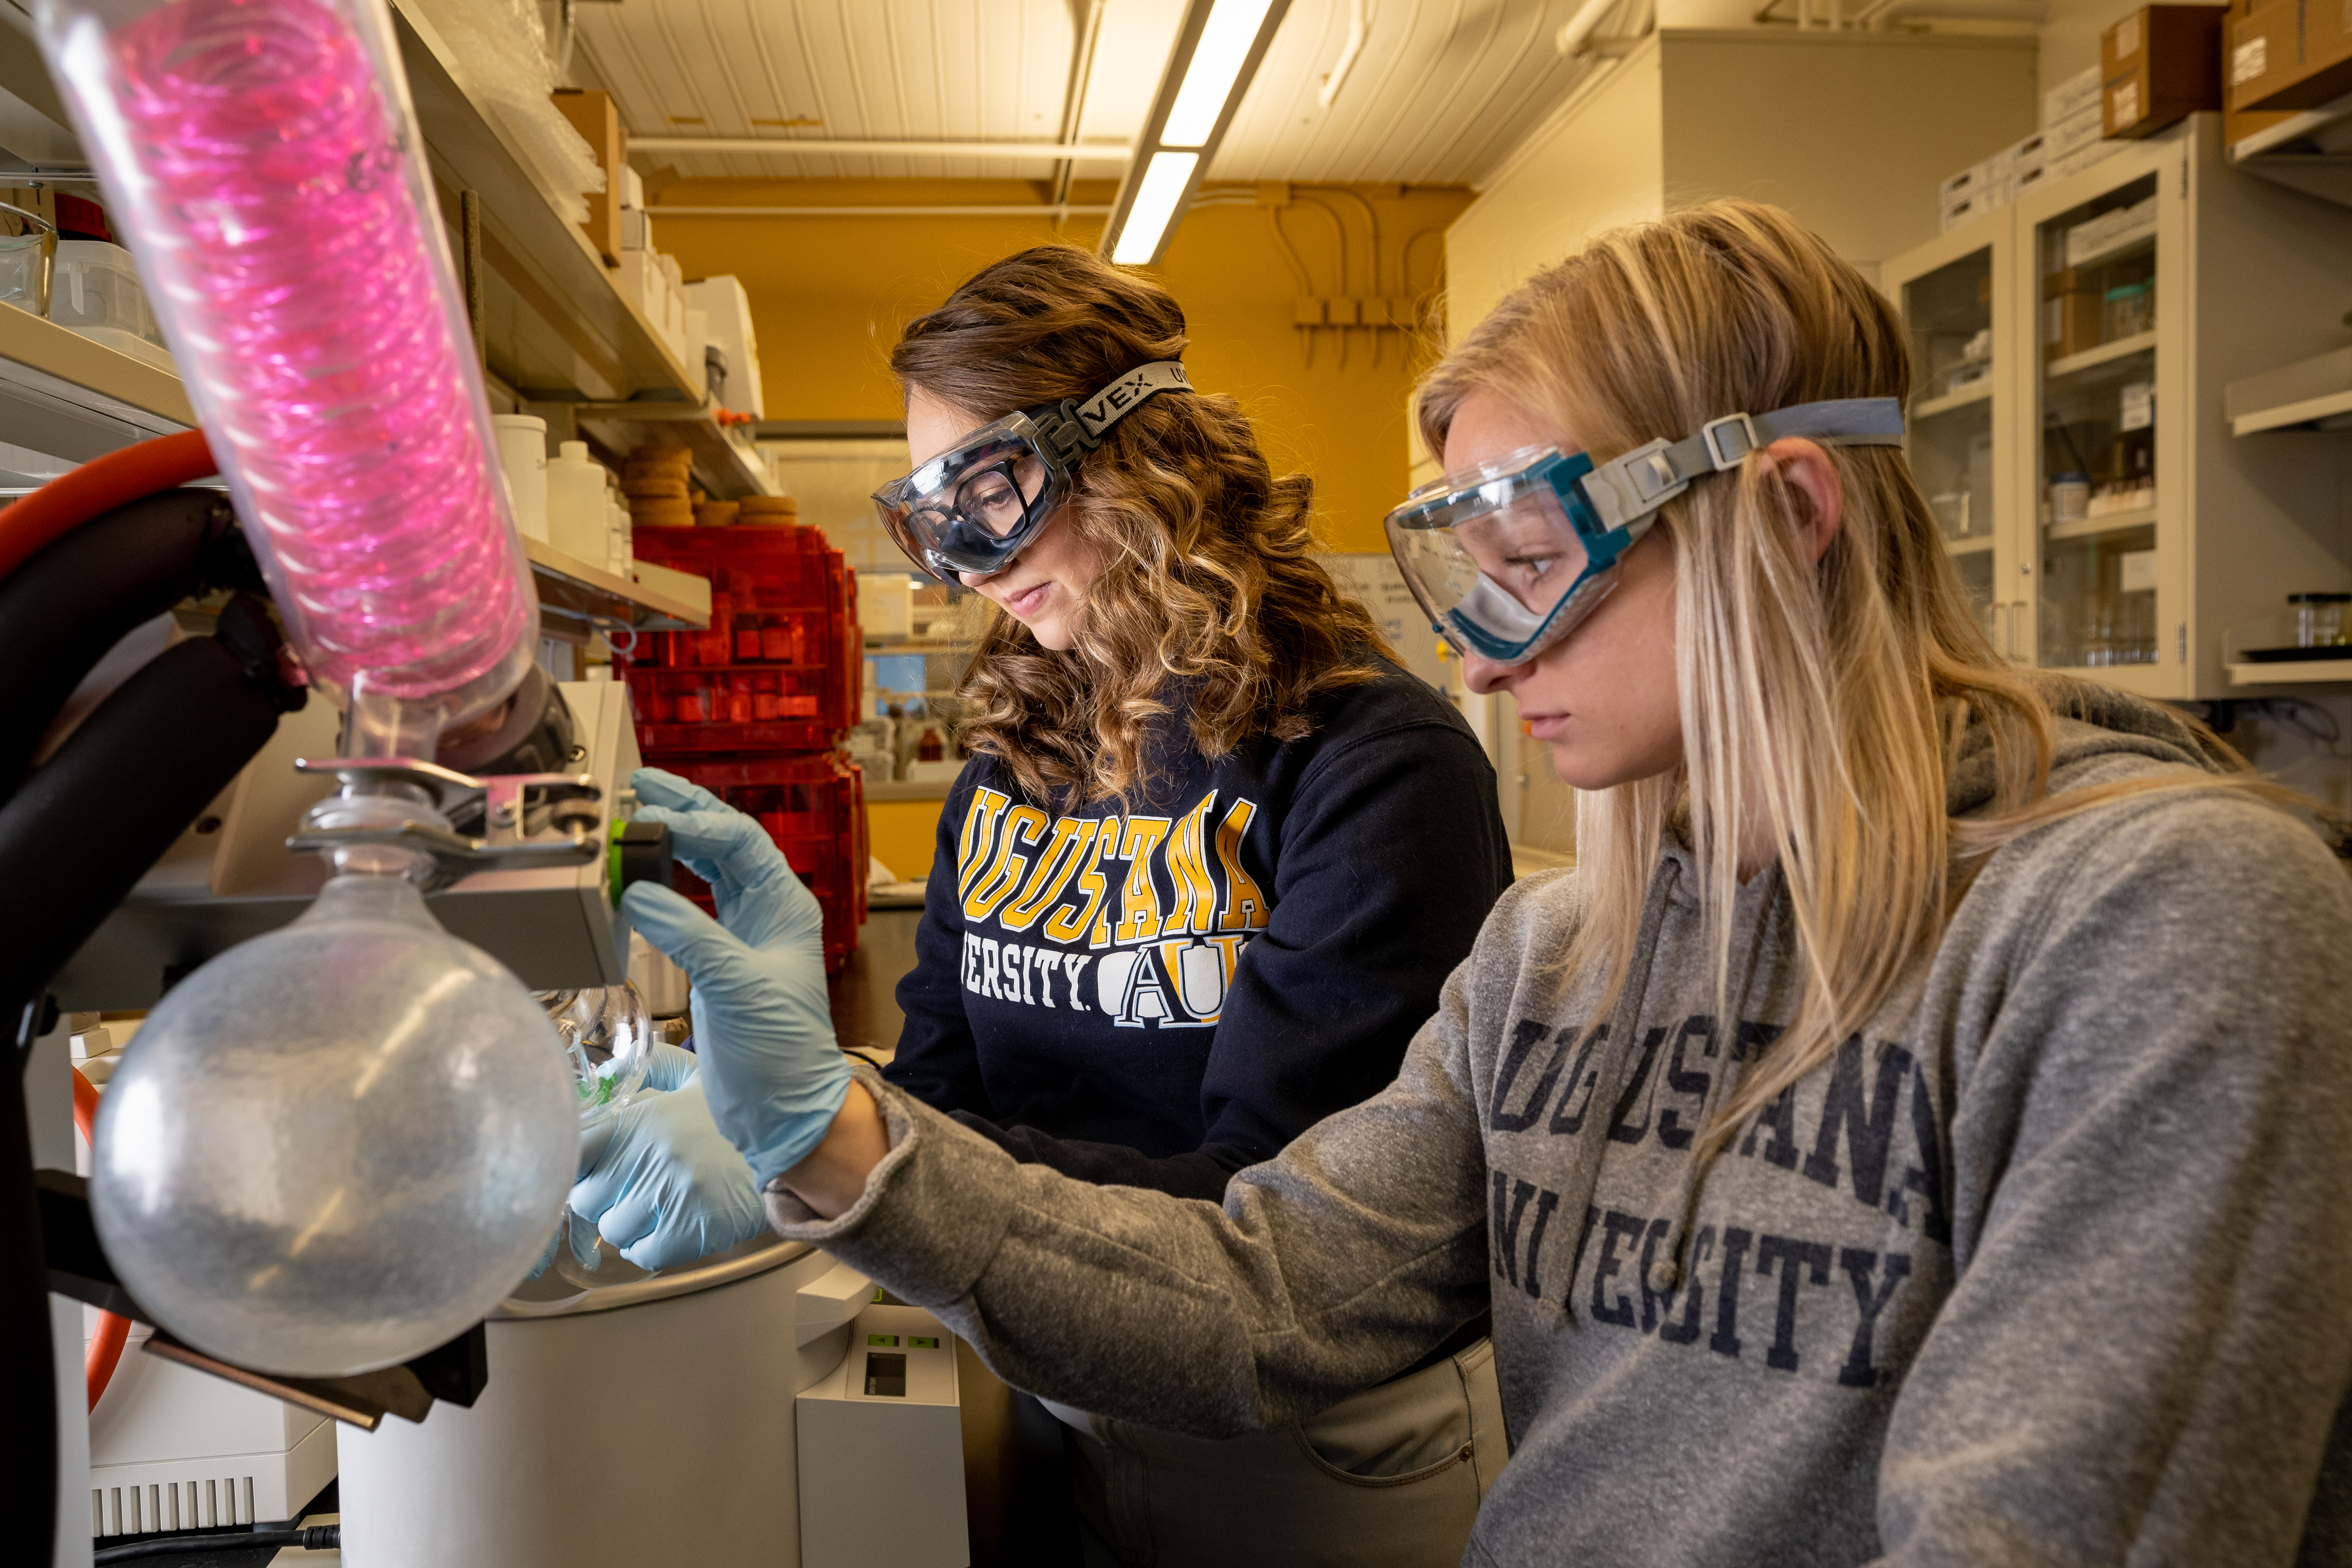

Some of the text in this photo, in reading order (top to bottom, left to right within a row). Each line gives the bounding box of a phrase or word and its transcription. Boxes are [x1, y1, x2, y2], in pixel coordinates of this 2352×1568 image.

[1169, 367, 1191, 385] UV
[962, 930, 1244, 1029] ERSITY AU
